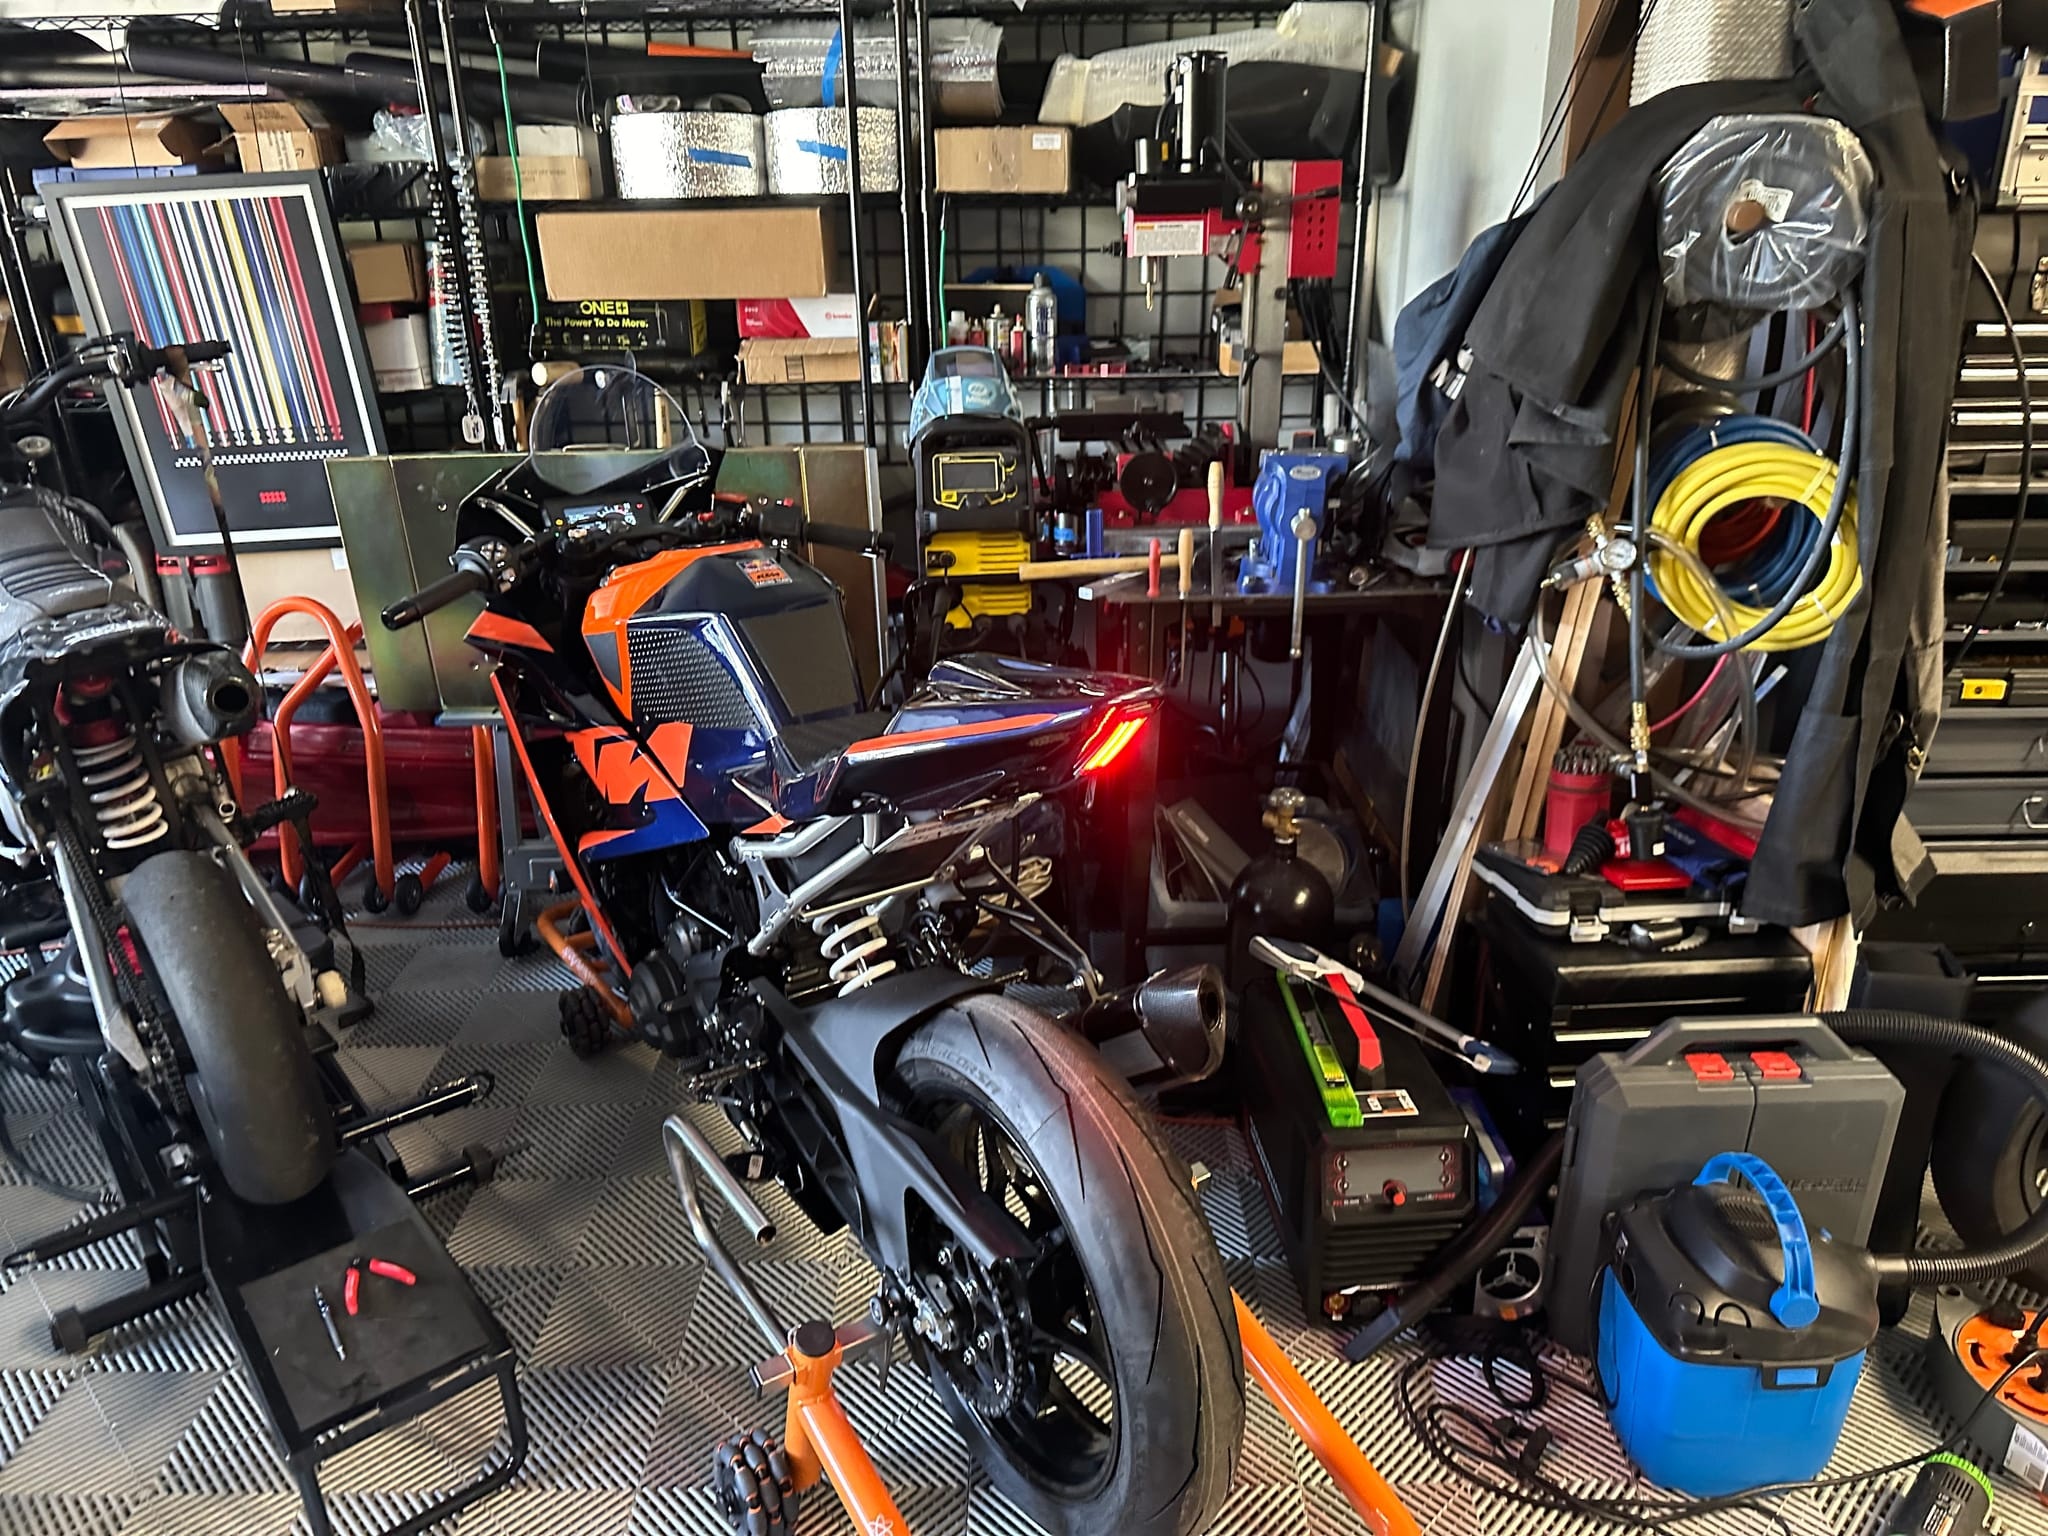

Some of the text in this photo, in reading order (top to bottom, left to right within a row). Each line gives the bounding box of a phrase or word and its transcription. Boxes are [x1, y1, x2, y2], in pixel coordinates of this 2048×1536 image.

[545, 317, 649, 328] The Power To Do More.
[563, 721, 694, 805] TM
